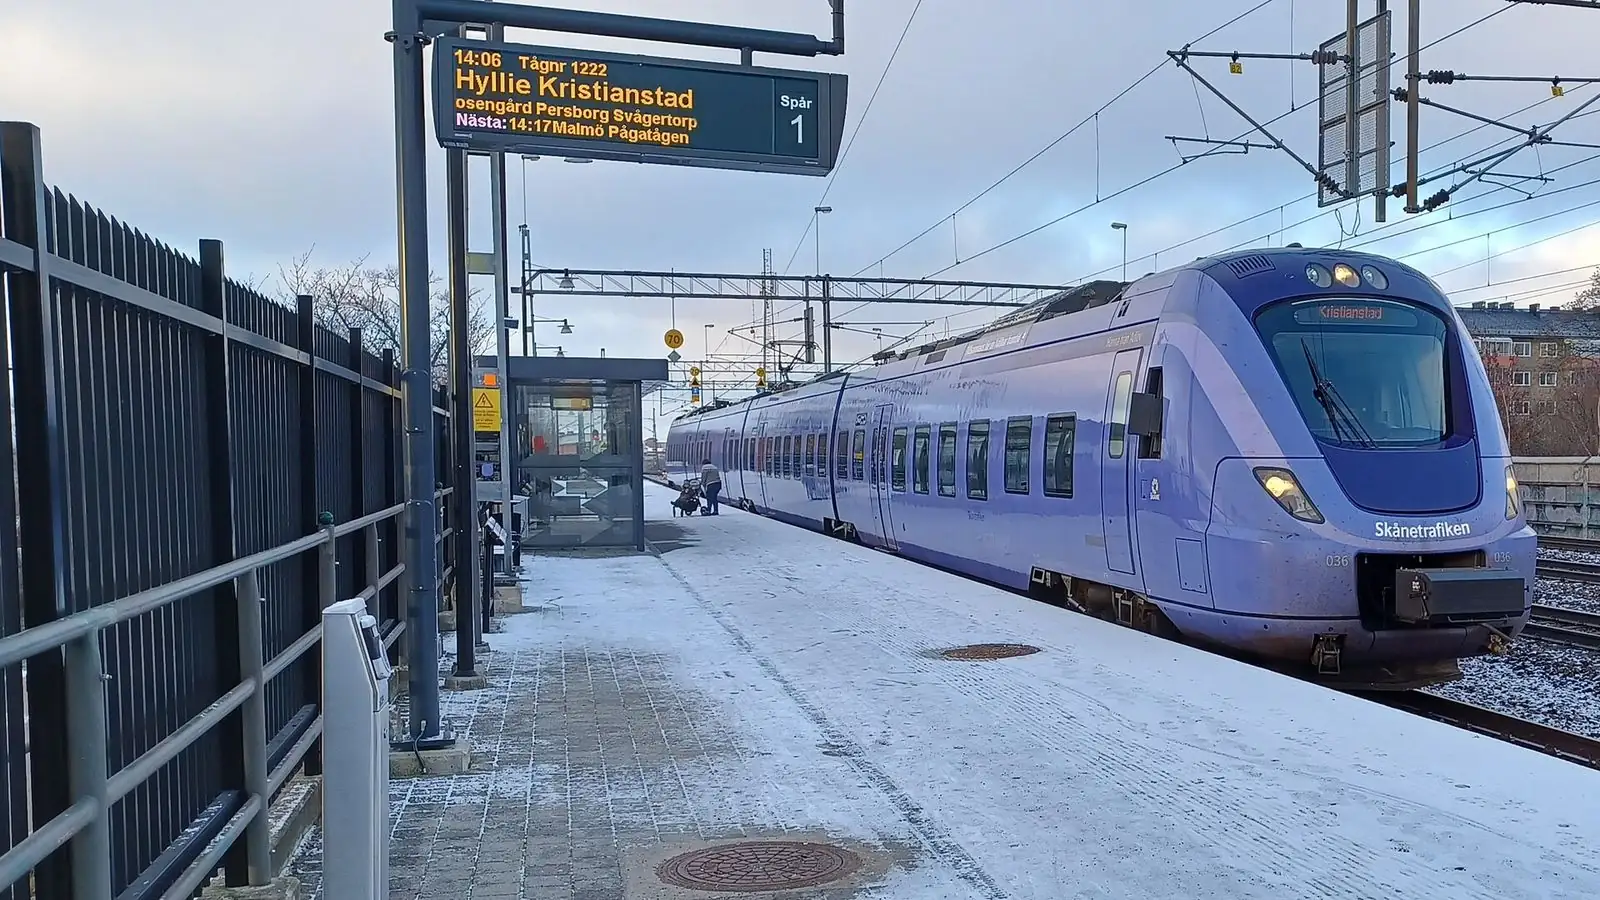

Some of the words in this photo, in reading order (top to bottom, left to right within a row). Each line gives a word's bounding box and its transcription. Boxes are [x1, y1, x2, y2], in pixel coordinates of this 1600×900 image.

[454, 49, 502, 68] 14:06
[518, 55, 567, 74] Tågnr
[571, 61, 608, 77] 1222
[456, 68, 531, 96] Hyllie
[539, 75, 693, 109] Kristianstad
[780, 95, 813, 110] Spår
[455, 98, 533, 115] osengård
[536, 102, 610, 124] Persborg
[613, 108, 698, 131] Svågertorp
[456, 112, 507, 130] Nästa:
[608, 124, 690, 146] Pågatågen
[790, 114, 803, 144] 1
[1319, 306, 1384, 320] Kristianstad
[668, 334, 680, 344] 70
[1375, 521, 1471, 539] Skånetrafiken
[1326, 555, 1349, 567] 036
[1494, 551, 1511, 563] 036
